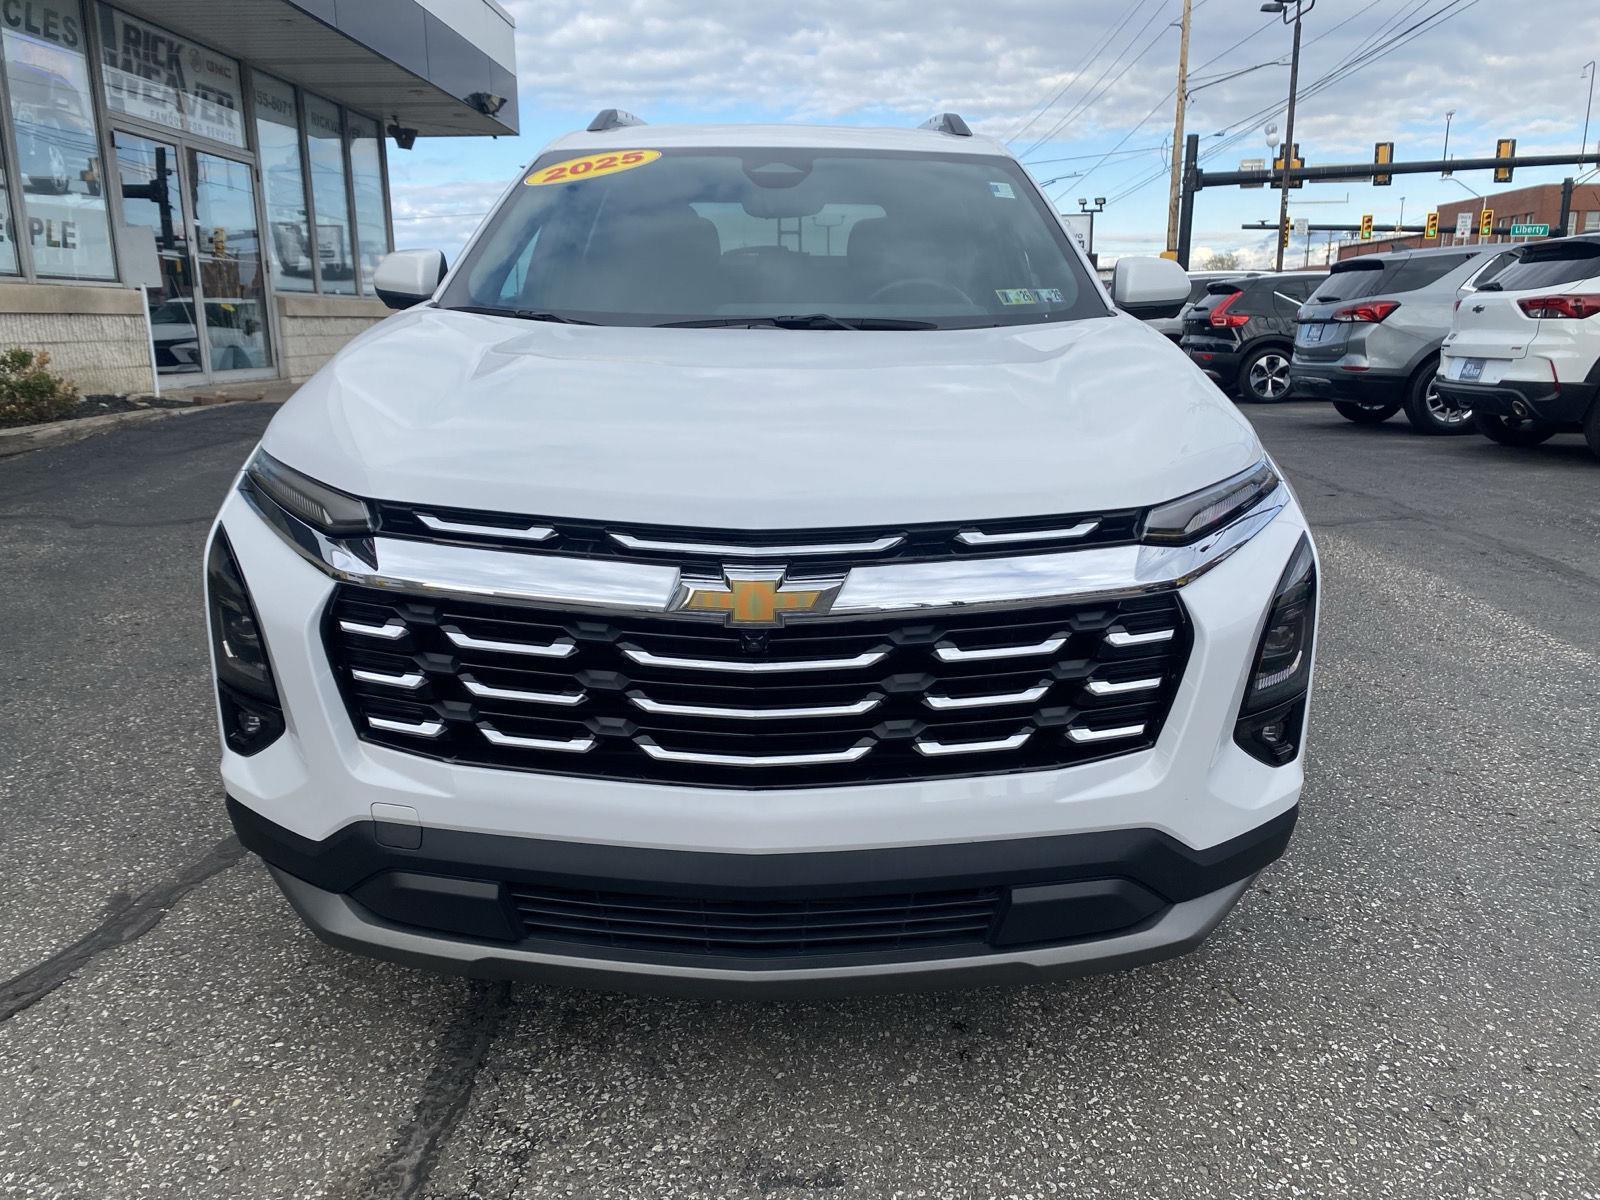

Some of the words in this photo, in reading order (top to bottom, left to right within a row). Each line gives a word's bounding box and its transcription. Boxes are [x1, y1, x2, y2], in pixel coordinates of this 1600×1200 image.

[2, 0, 78, 47] CLES
[122, 22, 184, 78] RICK
[104, 50, 235, 129] WEAVER
[542, 151, 644, 183] 2025
[1515, 224, 1545, 235] Liberty
